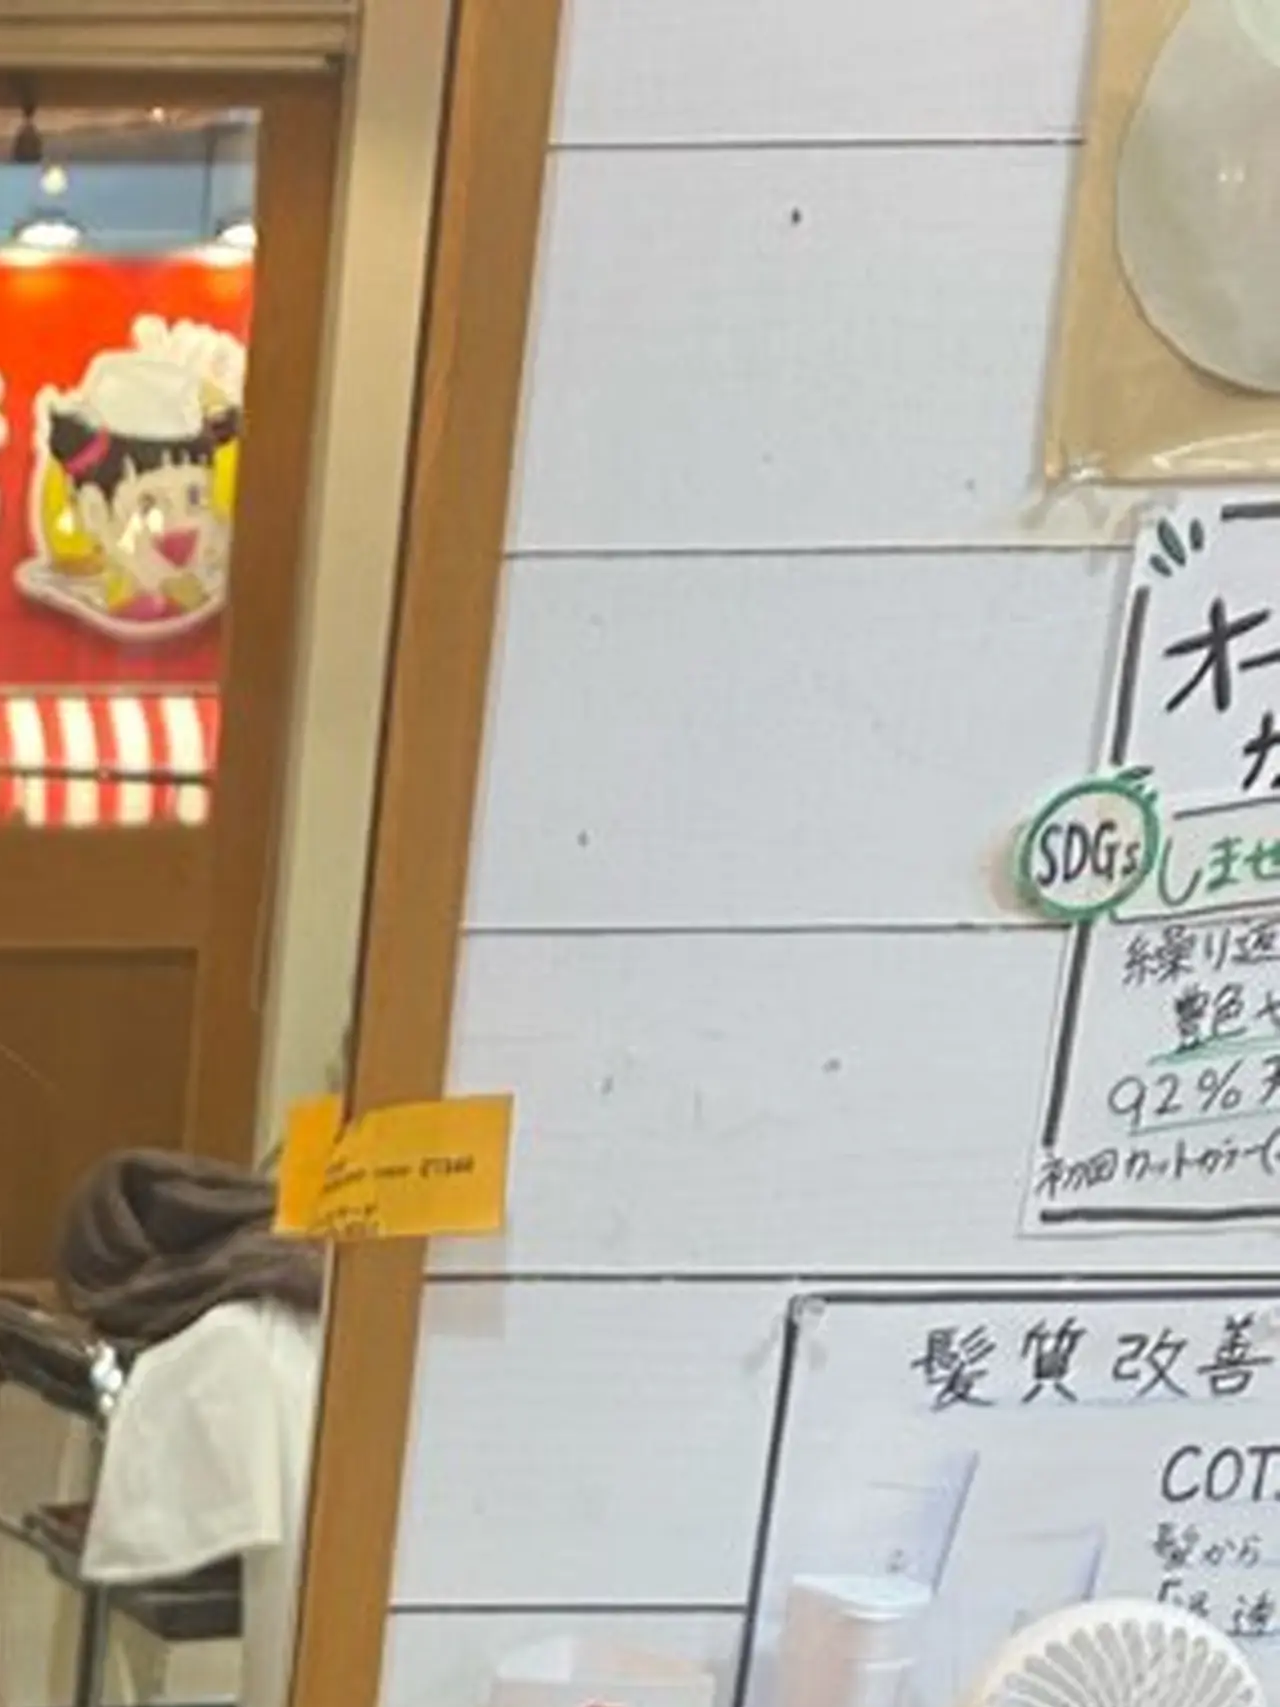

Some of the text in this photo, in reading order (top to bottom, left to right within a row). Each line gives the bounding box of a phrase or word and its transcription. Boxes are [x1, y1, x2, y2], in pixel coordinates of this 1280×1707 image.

[1037, 820, 1140, 886] SDGs
[910, 1314, 1274, 1413] 髪質改善
[1160, 1444, 1280, 1502] COT
